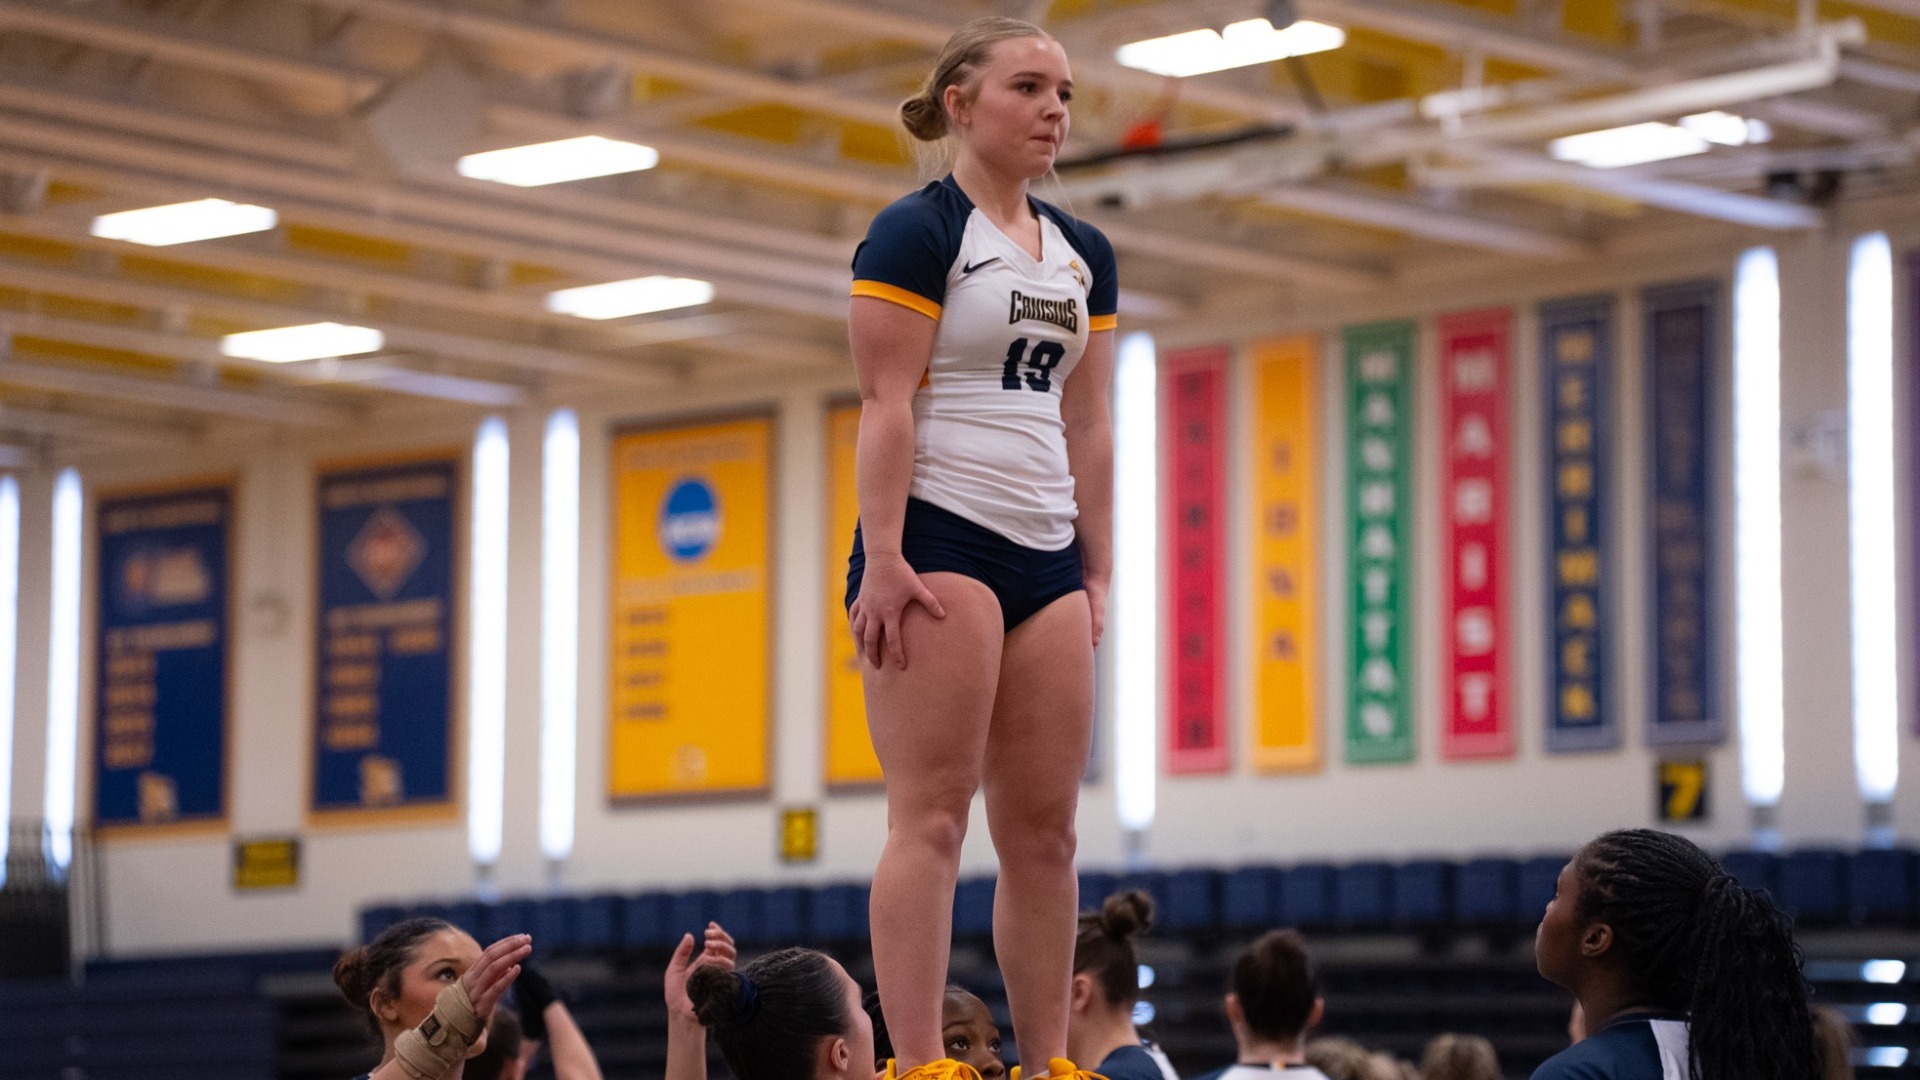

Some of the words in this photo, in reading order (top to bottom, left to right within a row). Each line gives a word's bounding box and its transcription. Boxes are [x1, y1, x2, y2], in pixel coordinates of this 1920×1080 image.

[1009, 290, 1077, 335] CANISIUS
[1002, 337, 1065, 392] 19
[1660, 762, 1703, 820] 7
